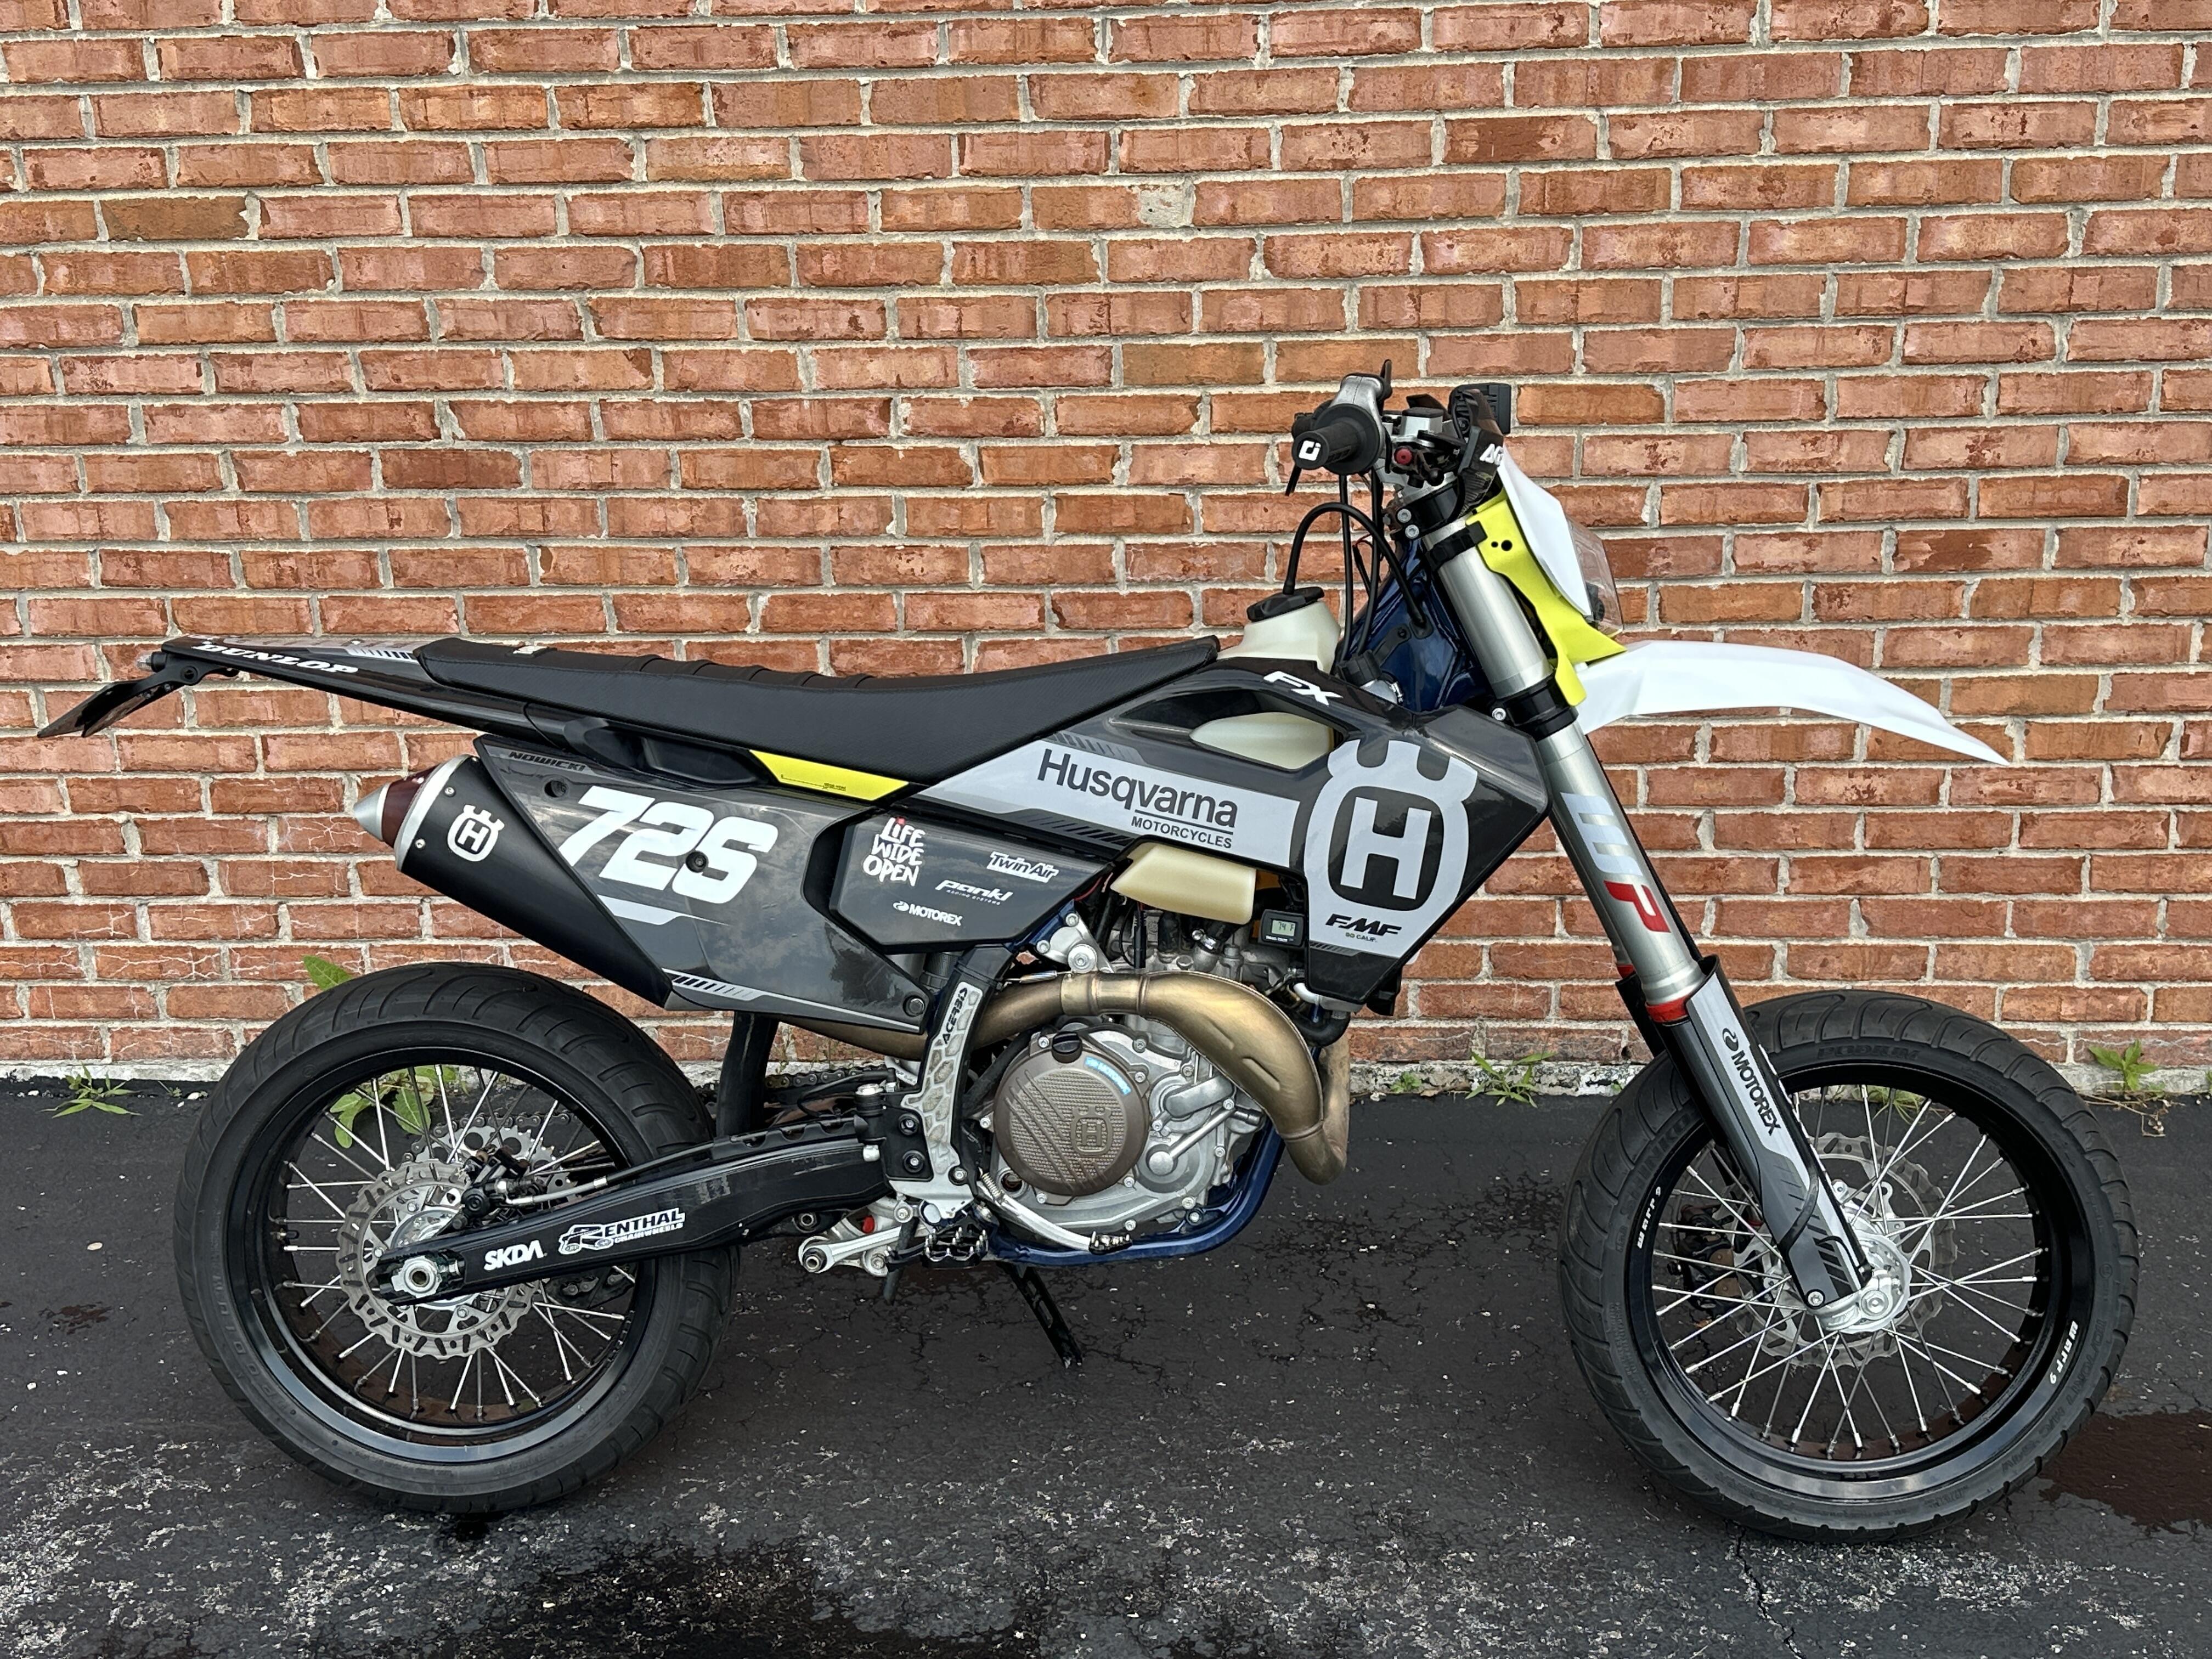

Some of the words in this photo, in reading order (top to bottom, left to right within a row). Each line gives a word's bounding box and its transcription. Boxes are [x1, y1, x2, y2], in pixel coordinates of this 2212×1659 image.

[191, 641, 359, 674] DUNLOP
[1264, 671, 1342, 706] FX
[508, 751, 586, 772] NOWICKI
[1037, 749, 1238, 828] Husqvarna
[1131, 816, 1232, 849] MOTORCYCLES
[871, 833, 924, 866] WIDE
[863, 854, 919, 887] OPEN
[909, 904, 963, 926] MOTOREX
[1325, 913, 1402, 936] FMF
[1731, 1051, 1781, 1136] MOTOREX
[483, 1240, 544, 1271] SKDA
